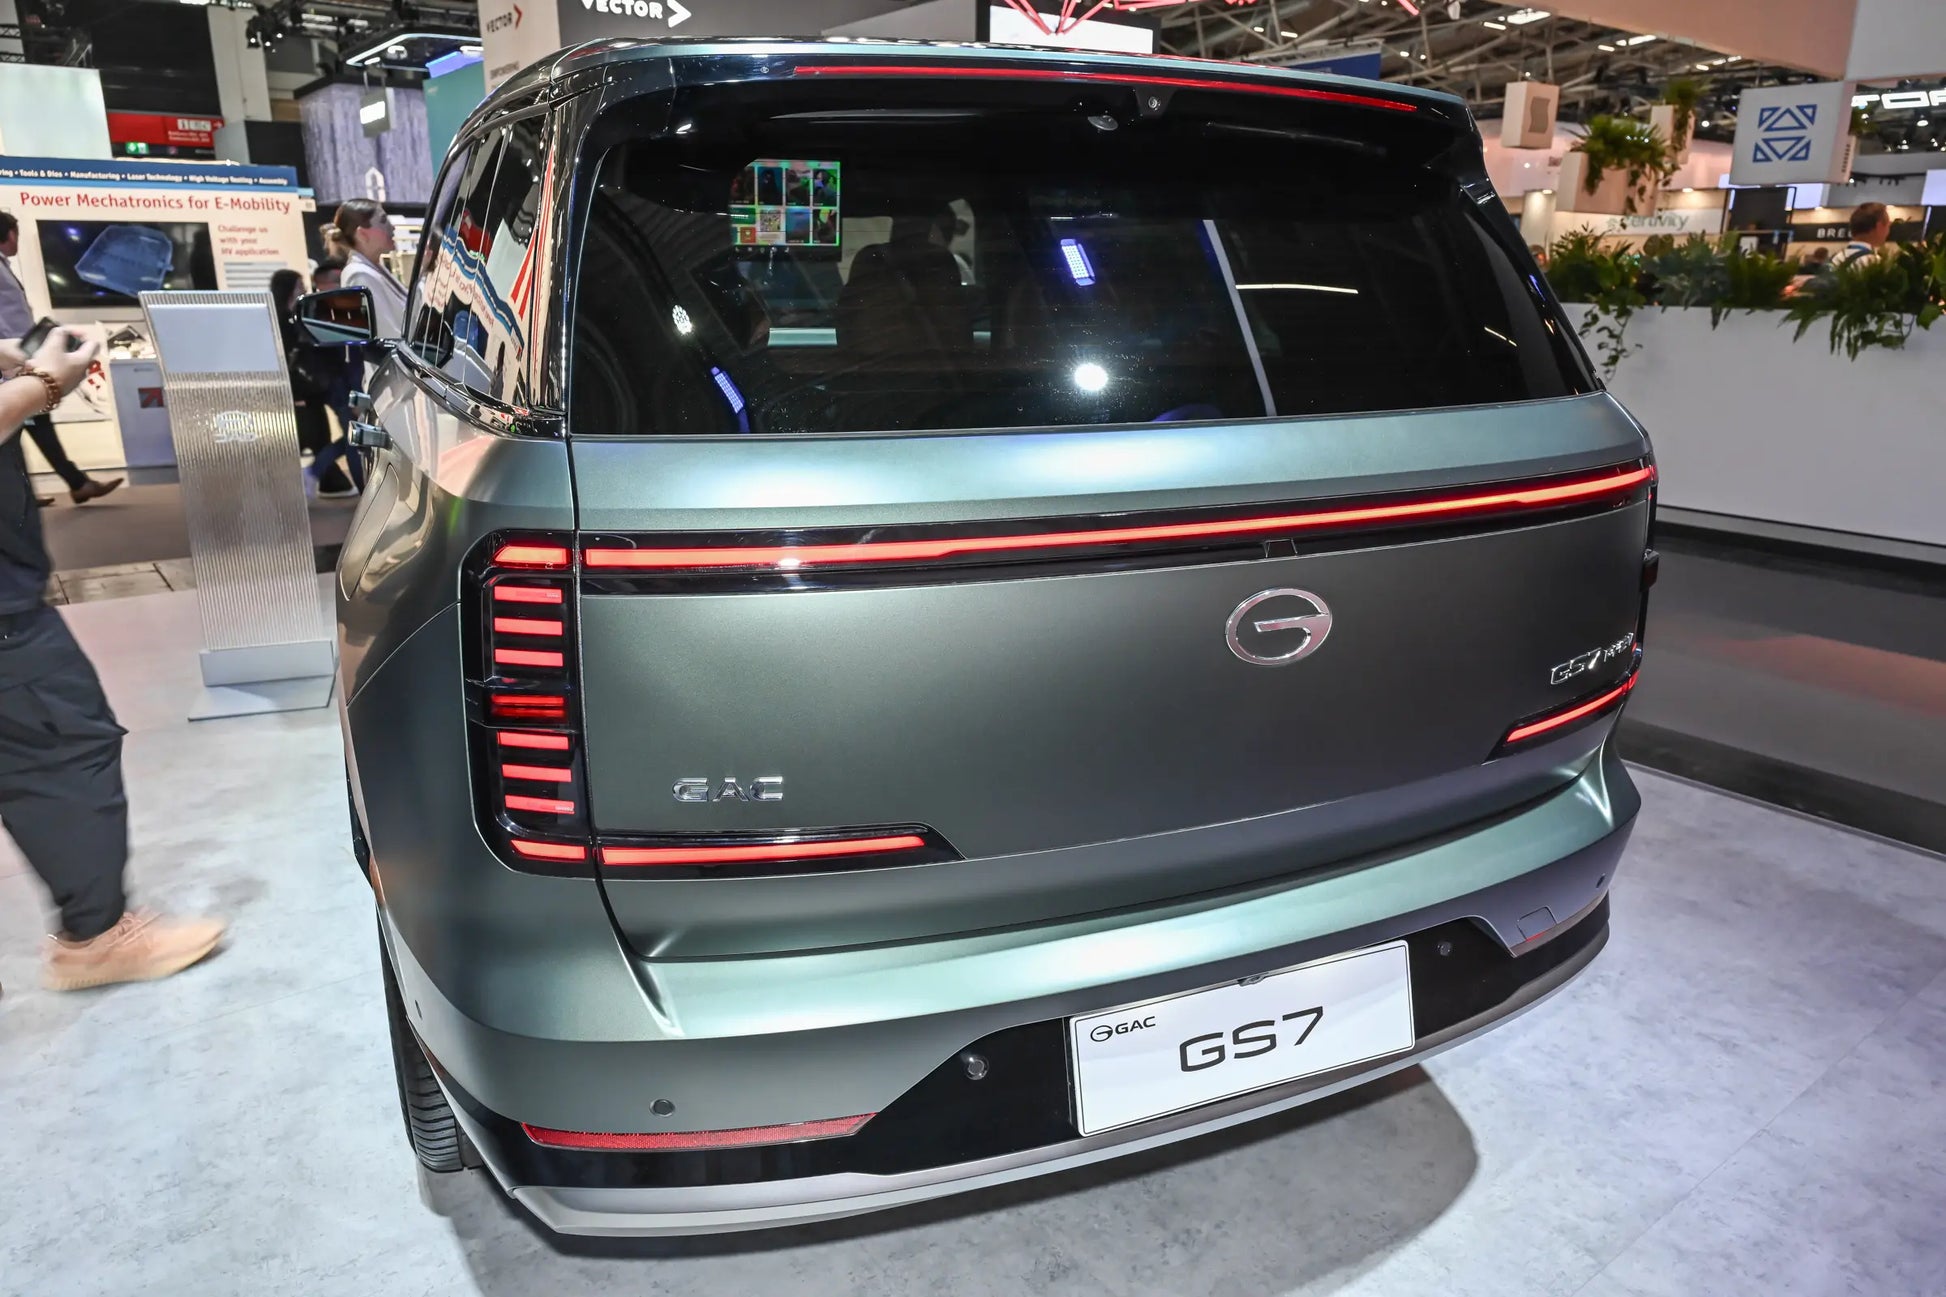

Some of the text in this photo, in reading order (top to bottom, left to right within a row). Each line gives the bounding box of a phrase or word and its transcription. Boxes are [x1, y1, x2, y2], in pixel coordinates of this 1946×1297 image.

[581, 0, 663, 19] VECTOR
[486, 12, 513, 32] VECTOR
[20, 169, 39, 177] Tools
[70, 171, 120, 181] Manufacturing
[146, 173, 182, 182] Technology
[188, 175, 204, 183] High
[20, 192, 290, 215] Power Mechatronics for E-Mobility
[218, 225, 256, 234] Challenge
[235, 248, 279, 256] application
[1550, 647, 1602, 685] GS7
[672, 776, 784, 803] GAC
[1115, 1016, 1156, 1036] GAC
[1179, 1006, 1323, 1073] GS7
